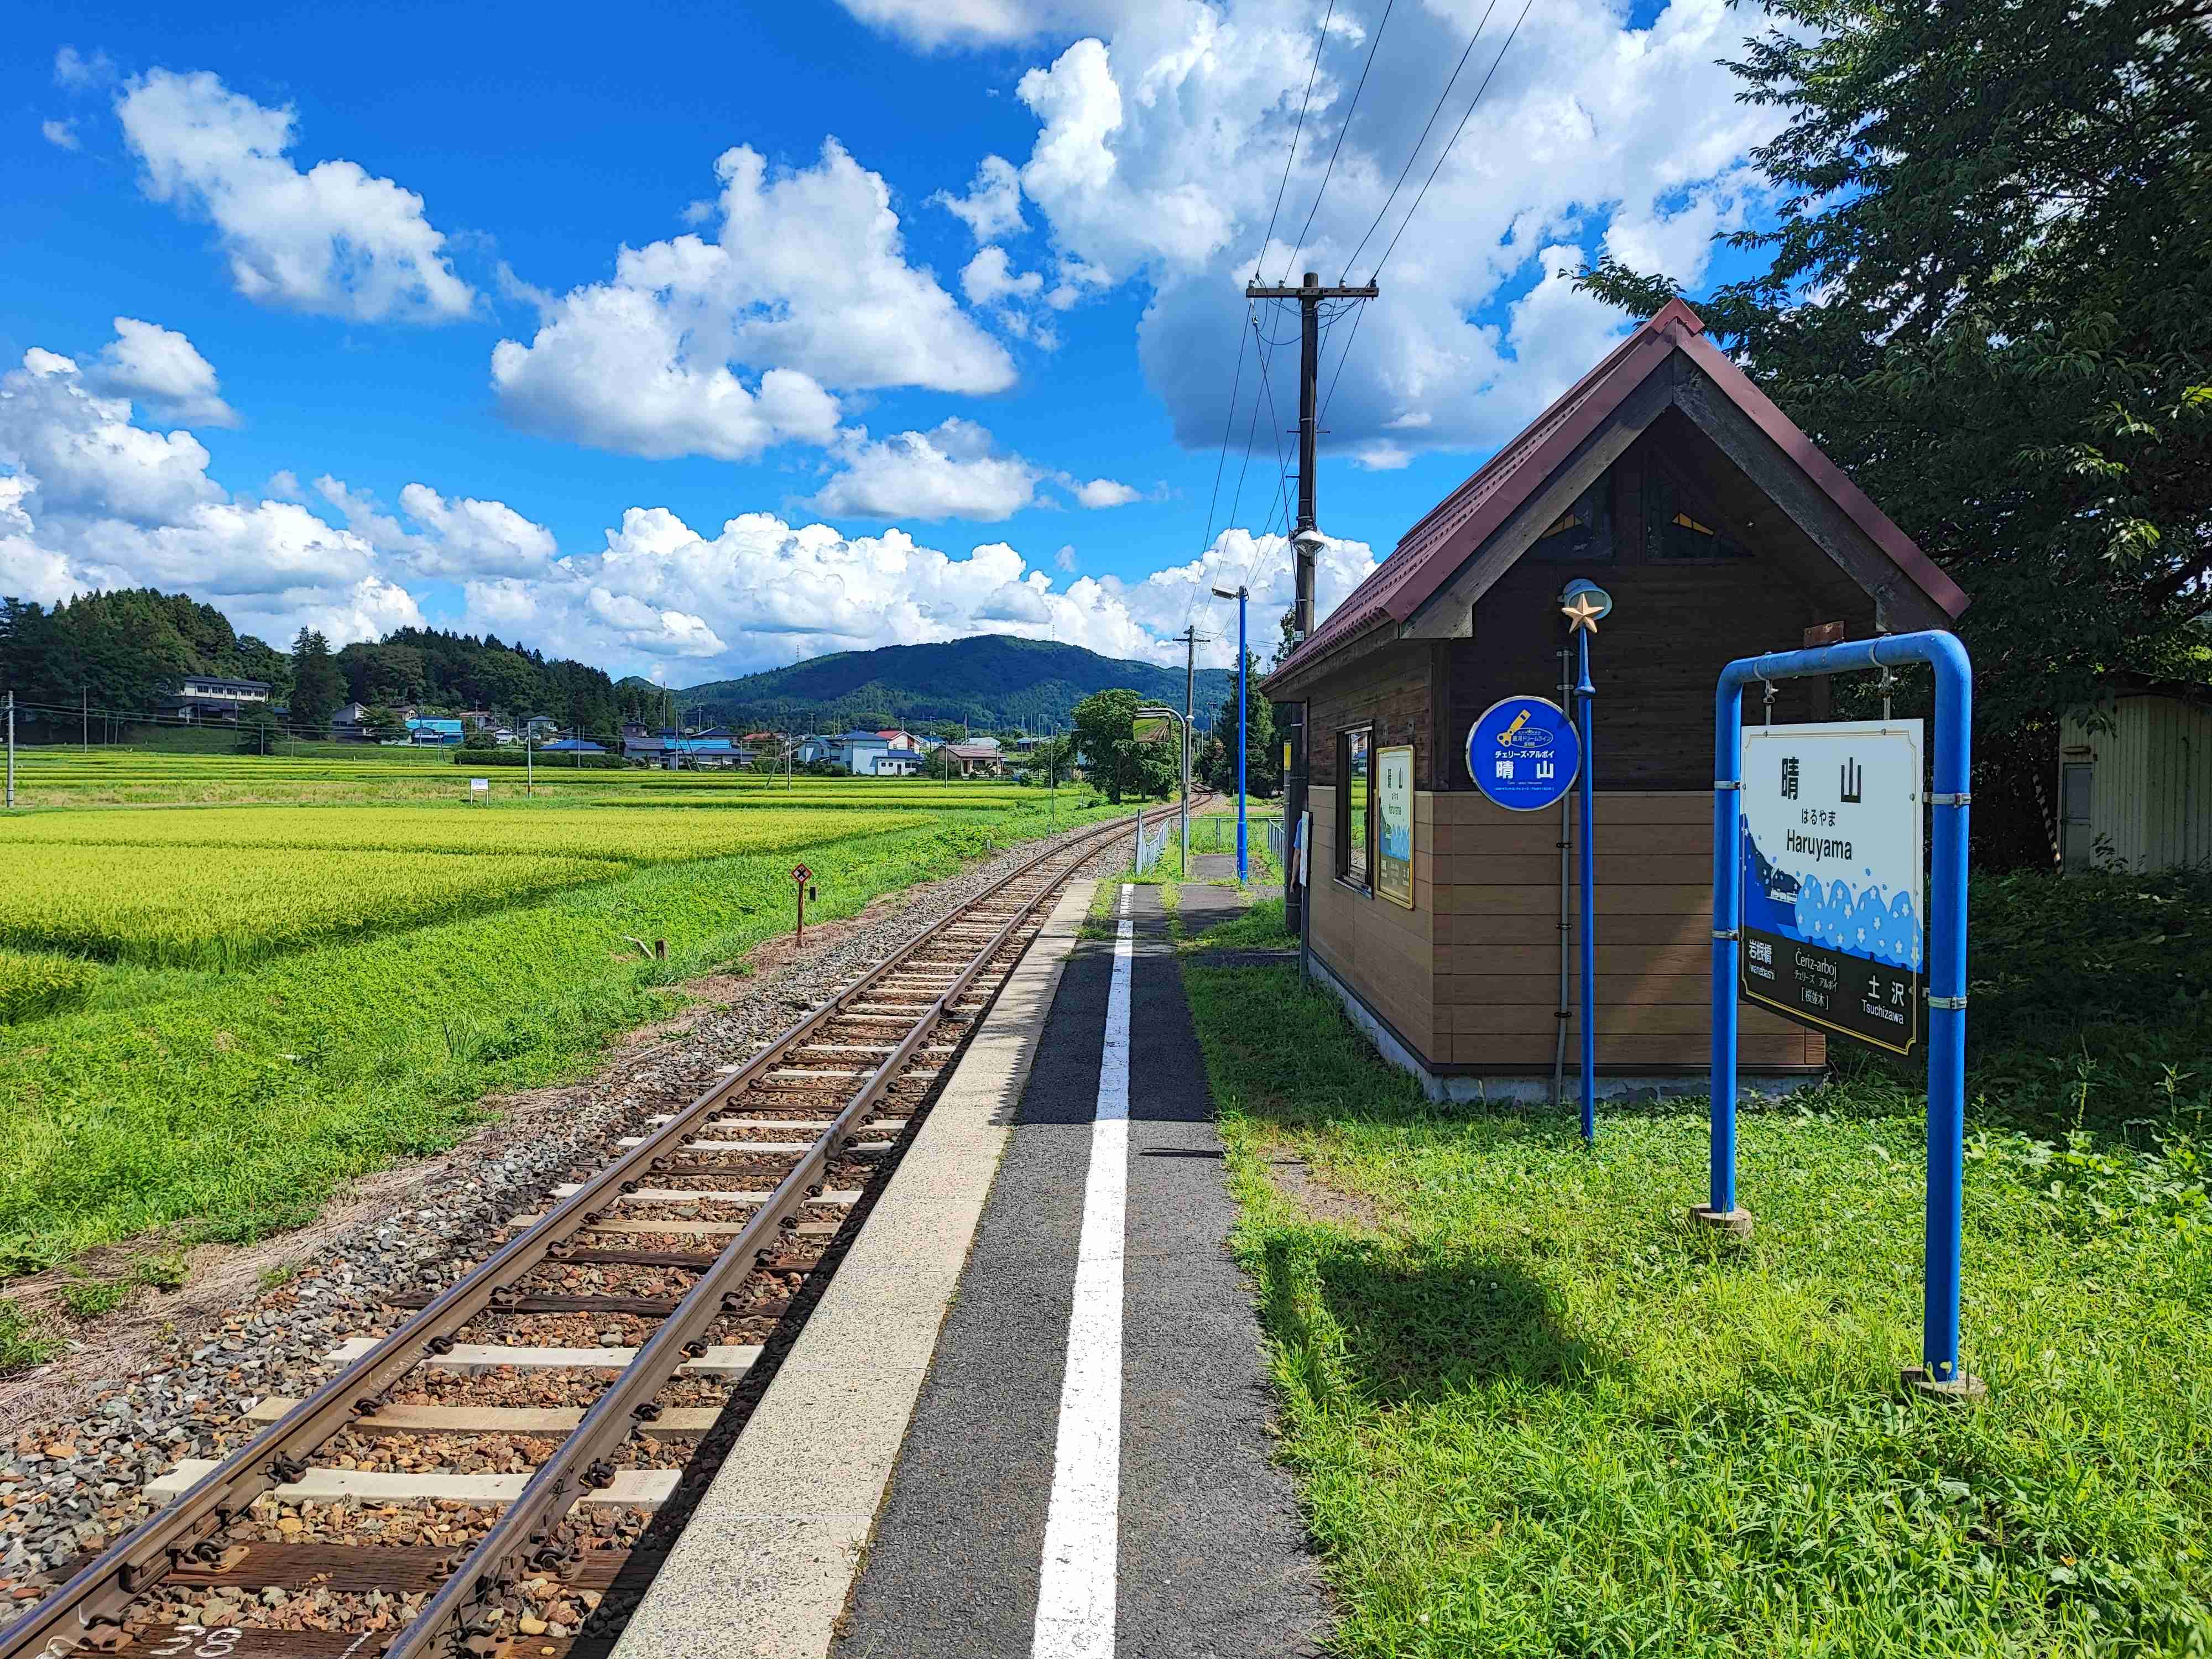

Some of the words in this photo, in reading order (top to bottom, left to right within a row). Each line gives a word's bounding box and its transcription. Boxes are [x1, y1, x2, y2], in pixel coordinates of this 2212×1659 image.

[1496, 760, 1554, 779] 晴山
[1781, 757, 1861, 804] 晴山
[1802, 808, 1836, 827] はるやま
[1787, 828, 1852, 862] Haruyama
[1749, 938, 1772, 966] 岩根橋
[1749, 961, 1775, 980] Iwanebashi
[1868, 975, 1905, 1007] 土沢
[1861, 999, 1904, 1025] Tsuchizawa
